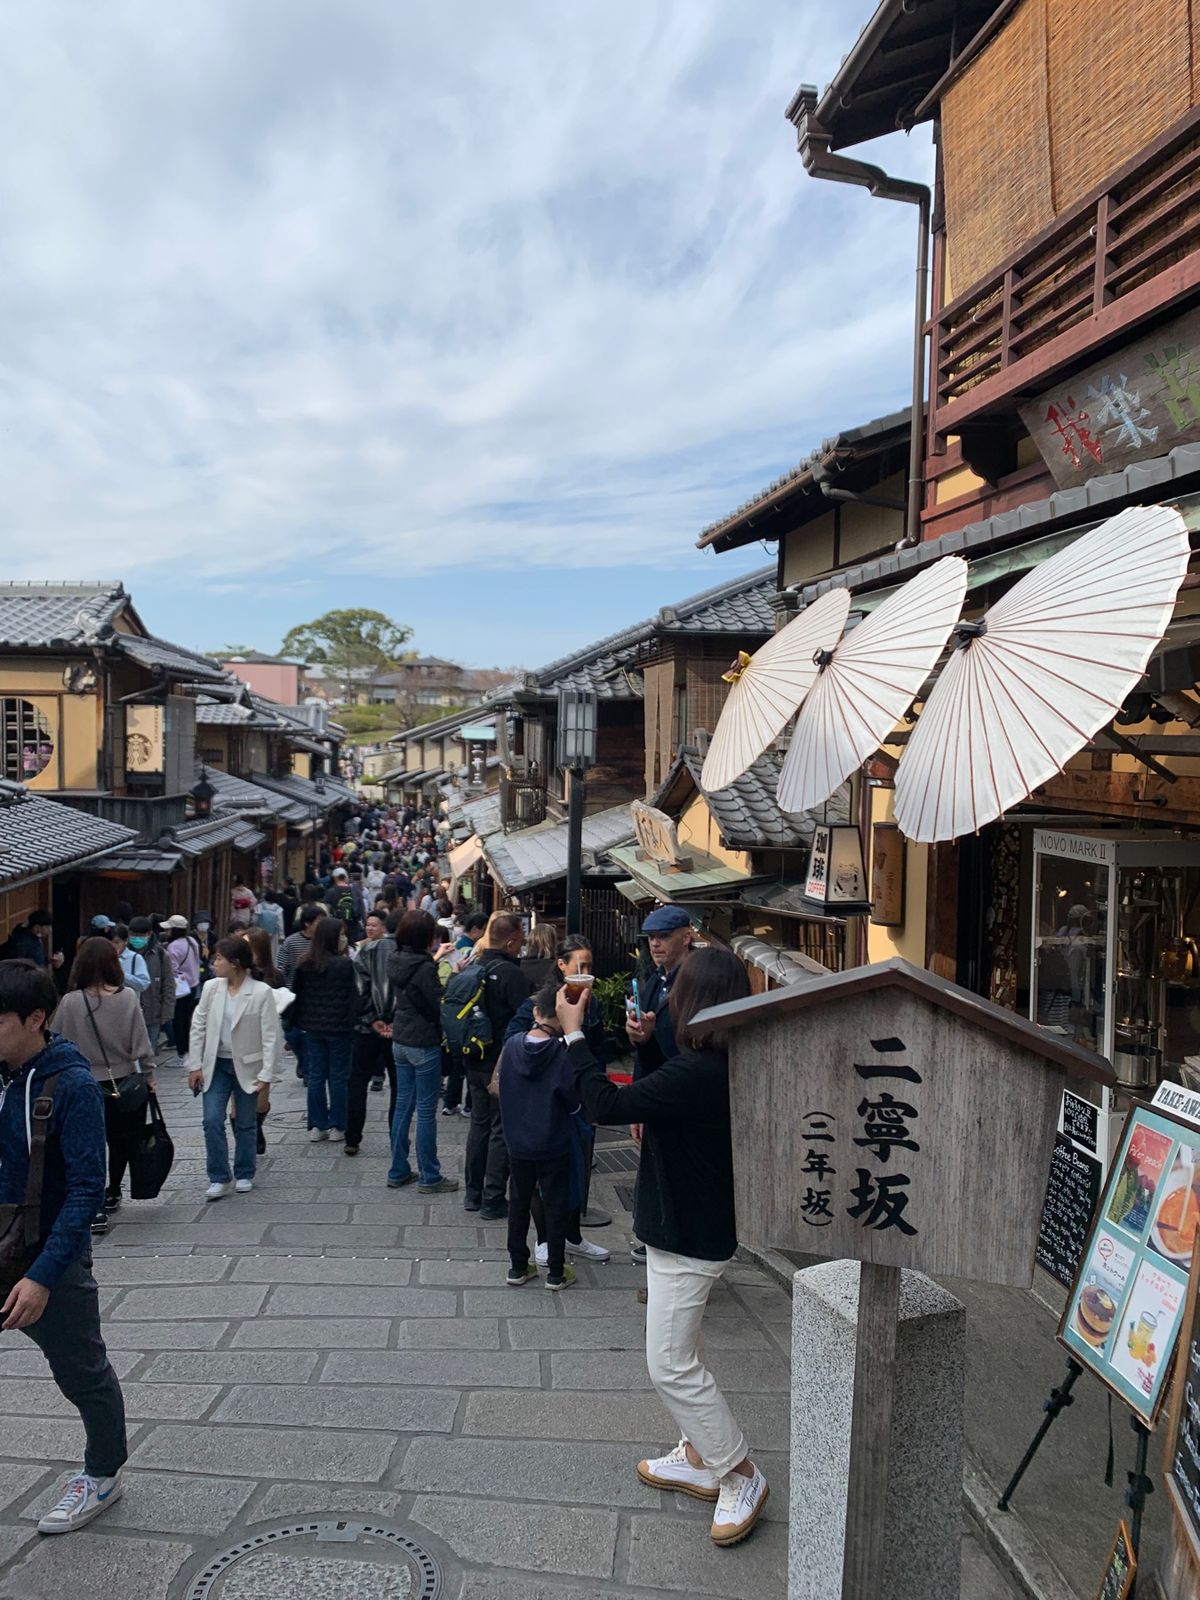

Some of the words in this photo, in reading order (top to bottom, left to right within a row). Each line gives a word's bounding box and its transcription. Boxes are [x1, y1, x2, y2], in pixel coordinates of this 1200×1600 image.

[812, 831, 828, 881] 珈琲
[1040, 834, 1067, 852] NOVO
[1069, 839, 1098, 858] MARK
[807, 881, 826, 897] COFFEE
[847, 1036, 922, 1236] 二寧坂
[799, 1110, 837, 1228] (二年坂)
[1053, 1144, 1072, 1162] offee
[1072, 1152, 1090, 1173] Beans
